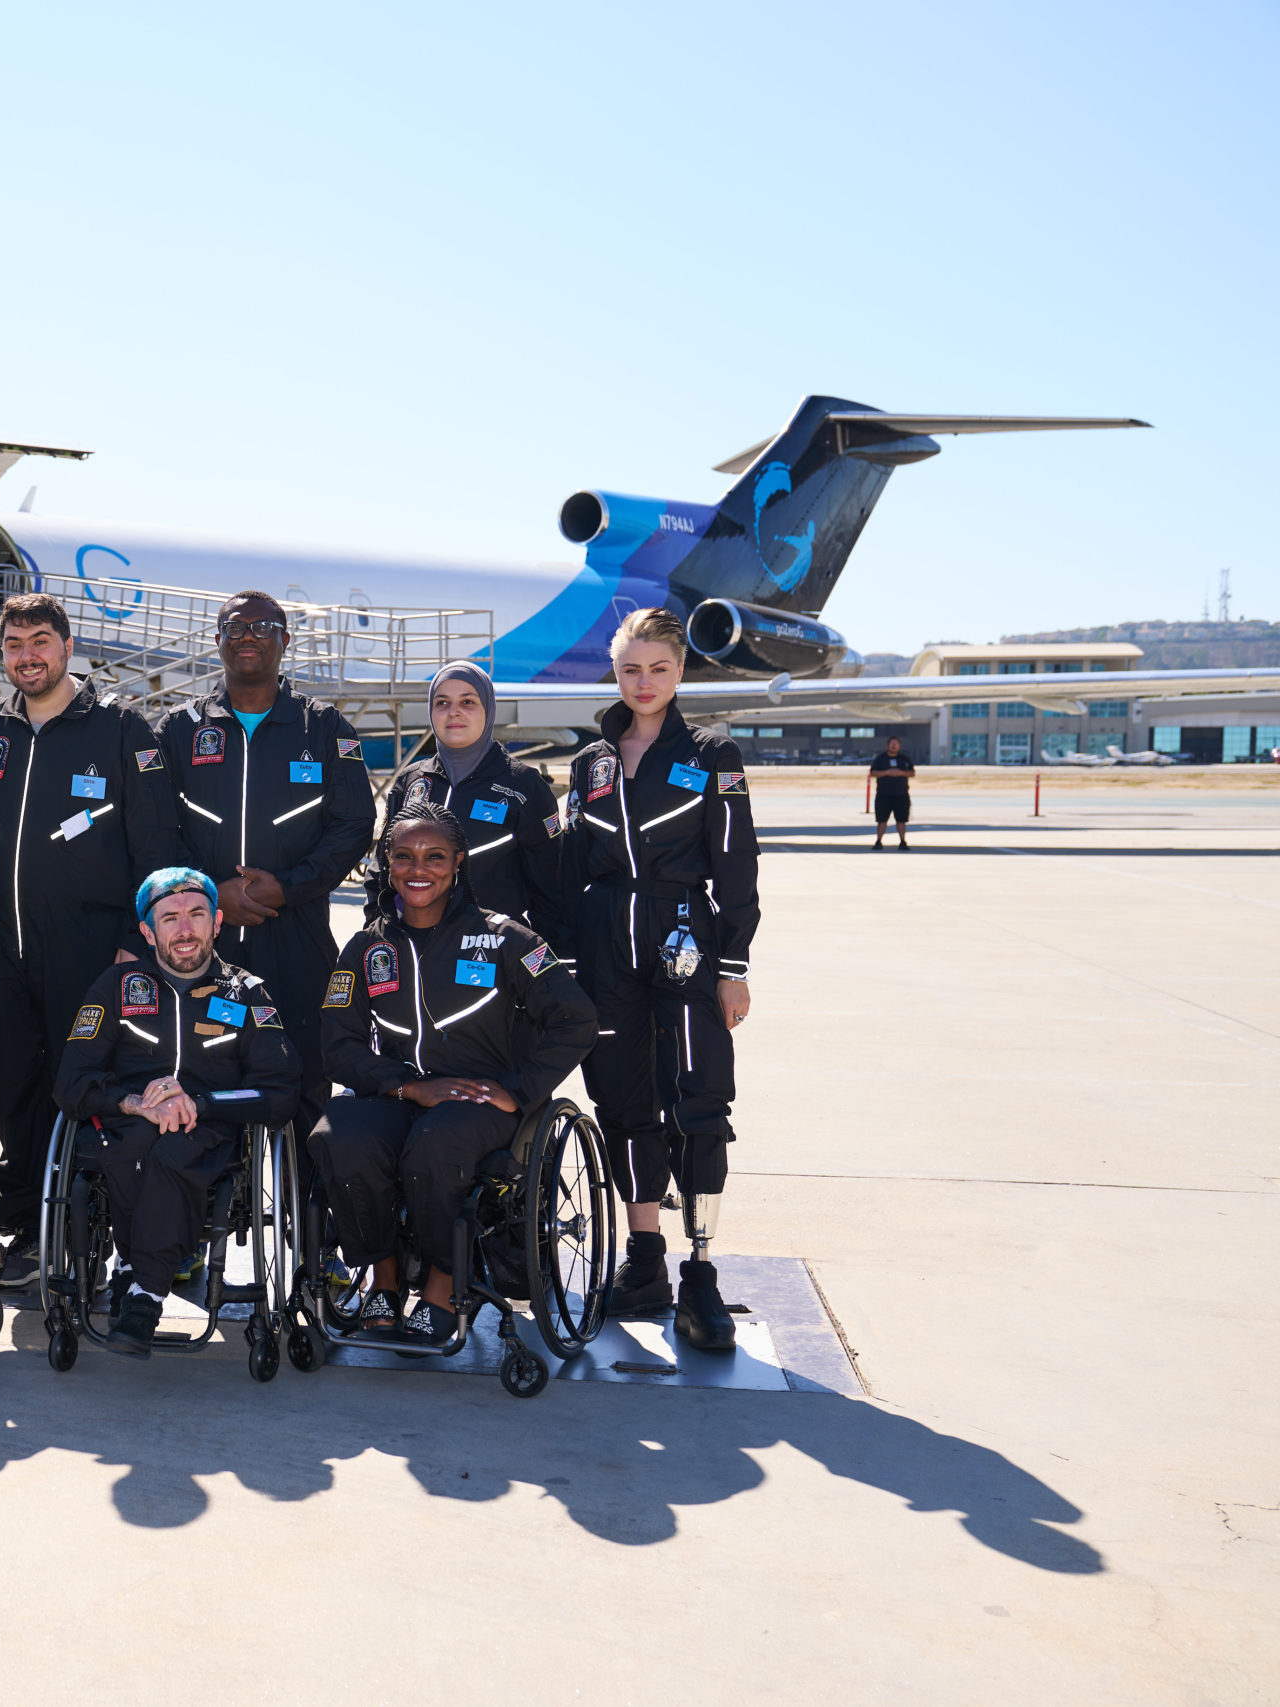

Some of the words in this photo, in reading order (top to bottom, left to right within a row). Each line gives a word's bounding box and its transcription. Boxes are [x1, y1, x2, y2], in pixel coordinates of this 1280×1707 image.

[658, 513, 695, 534] N794AJ
[460, 933, 506, 950] DAV
[222, 1002, 235, 1010] Eric
[361, 1307, 395, 1319] adidas
